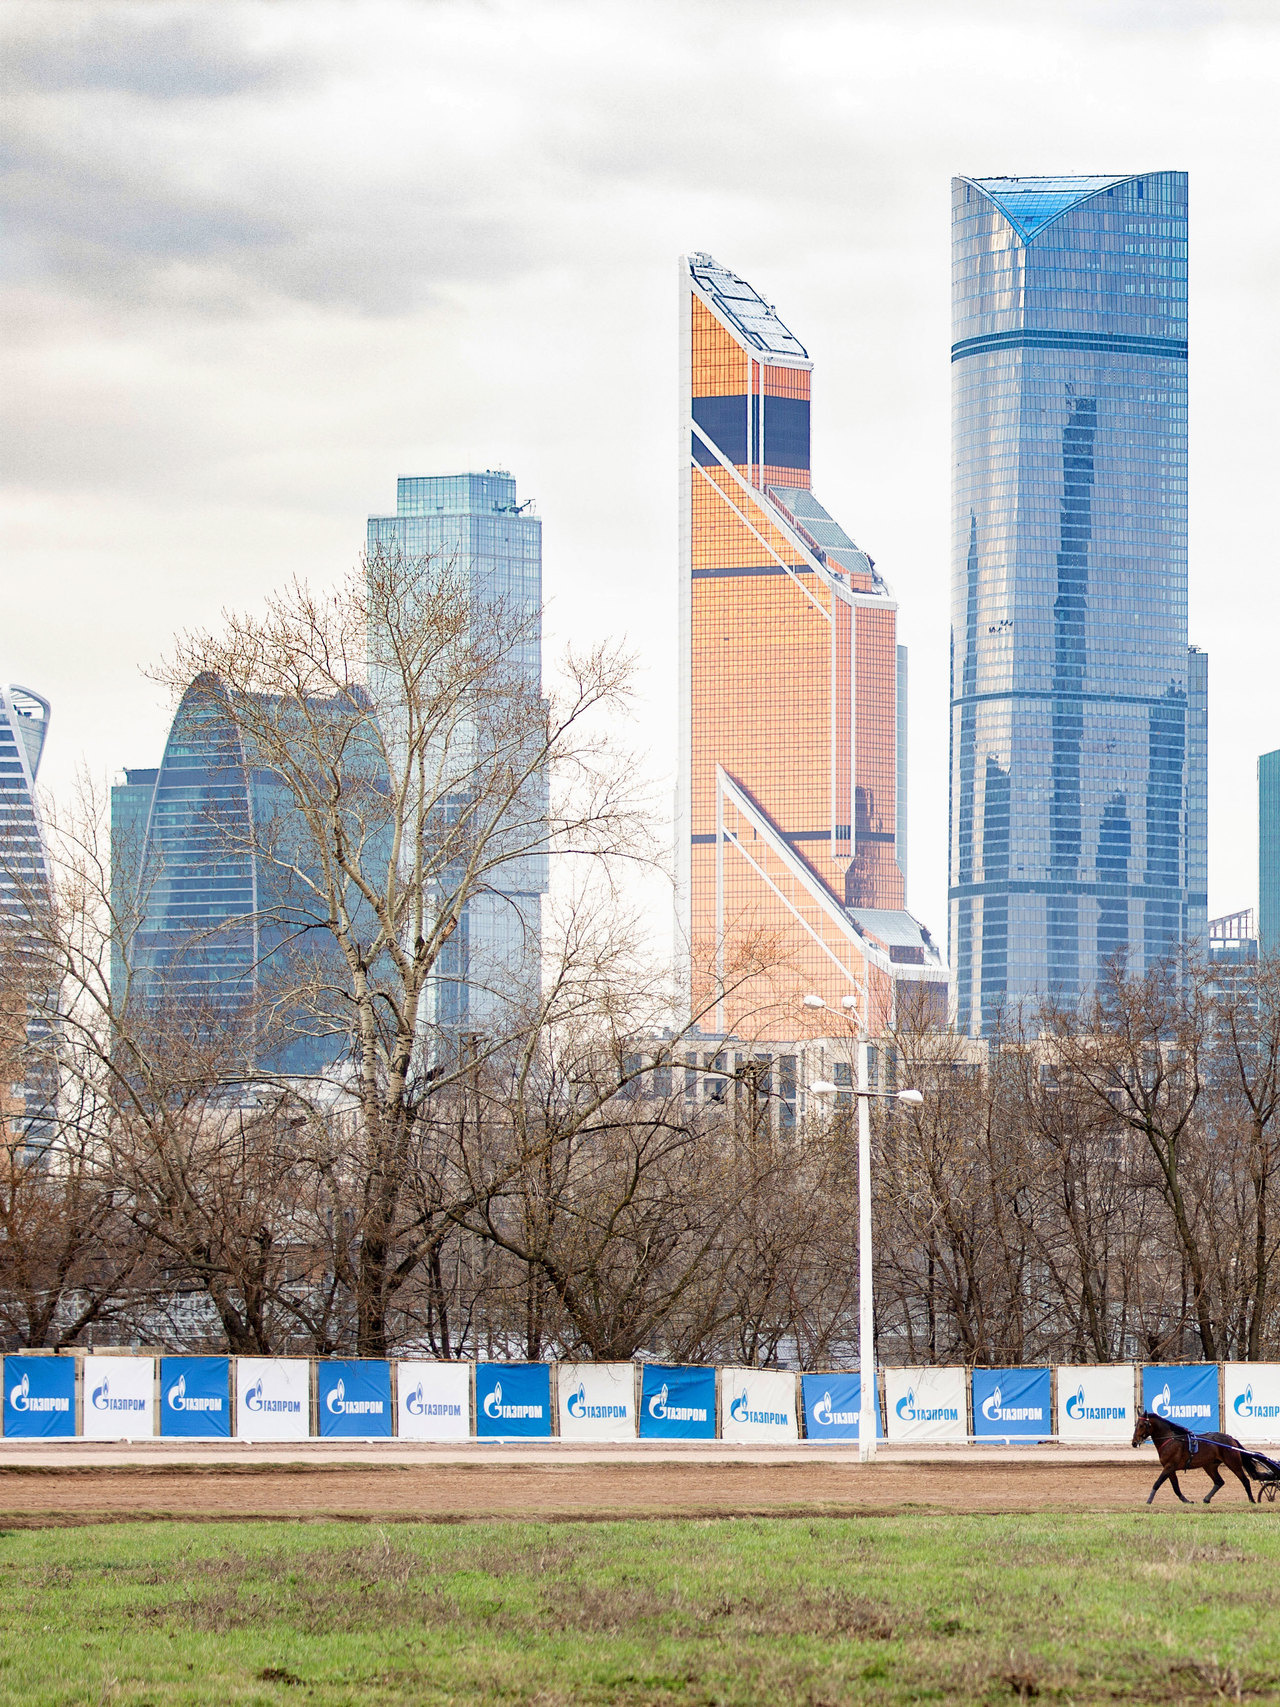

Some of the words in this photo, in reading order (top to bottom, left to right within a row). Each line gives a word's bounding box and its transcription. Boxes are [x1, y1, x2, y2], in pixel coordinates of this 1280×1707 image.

[29, 1398, 69, 1411] ГАЗПРОМ
[110, 1399, 145, 1410] ГАЗПРОМ
[186, 1398, 221, 1410] ГАЗПРОМ
[263, 1401, 300, 1412] ГАЗПРОМ
[346, 1401, 383, 1413] ГАЗПРОМ
[425, 1404, 460, 1415] ГАЗПРОМ
[502, 1406, 542, 1418] ГАЗПРОМ
[587, 1406, 626, 1418] ГАЗПРОМ
[667, 1407, 706, 1421] ГАЗПРОМ
[917, 1409, 958, 1420] ГАЗПРОМ
[1002, 1408, 1042, 1420] ГАЗПРОМ
[1085, 1408, 1125, 1419] ГАЗПРОМ
[1172, 1405, 1211, 1417] ГАЗПРОМ
[750, 1412, 787, 1424] ГАЗПРОМ
[834, 1413, 859, 1424] ГАЗПР
